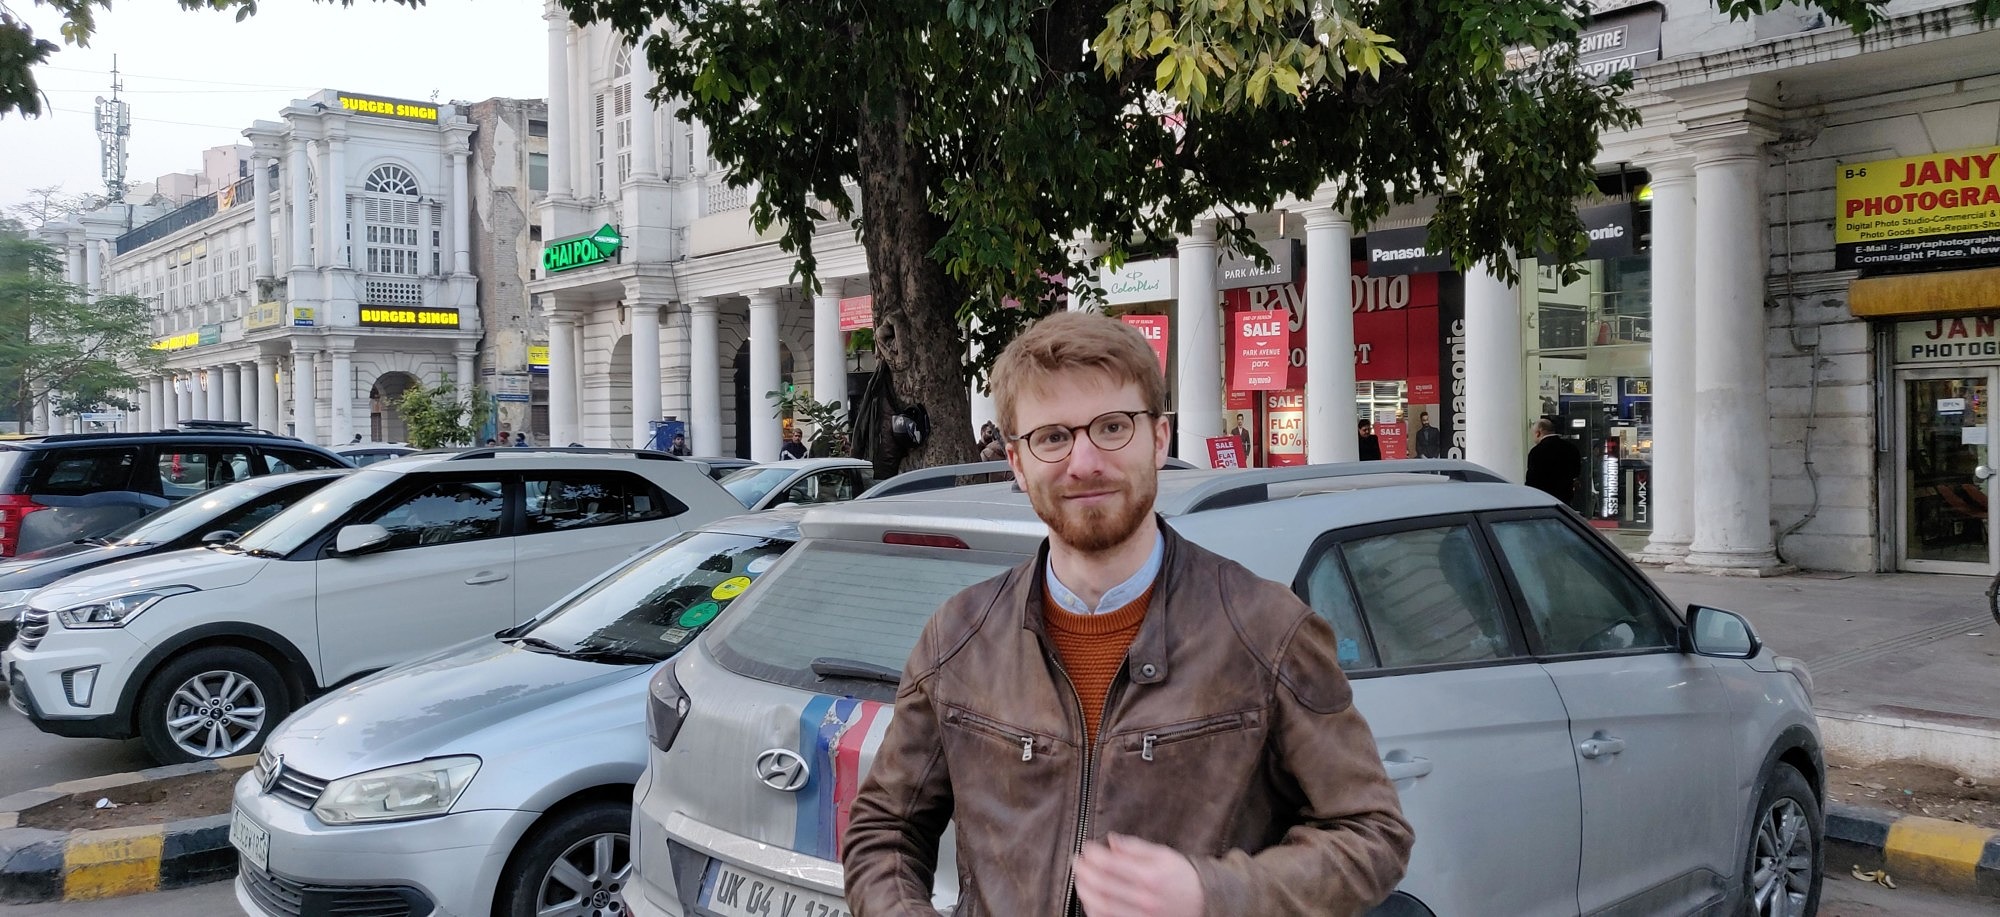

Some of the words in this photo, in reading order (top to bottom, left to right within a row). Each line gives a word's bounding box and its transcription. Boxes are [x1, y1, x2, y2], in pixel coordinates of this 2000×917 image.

[1579, 31, 1622, 54] ENTRE
[340, 97, 395, 115] BURGER
[396, 105, 437, 120] SINGH
[1845, 168, 1867, 179] B-6
[1900, 152, 2000, 188] JANY
[1846, 221, 1873, 231] Digital
[1875, 218, 1899, 228] Photo
[1902, 210, 1987, 226] Studio-Commercial
[1990, 210, 1996, 218] &
[1860, 230, 1885, 239] Photo
[1888, 227, 1915, 236] Goods
[1855, 243, 1887, 254] E-Mail
[1855, 250, 1924, 264] Connaught
[1927, 248, 1967, 260] Place,
[1970, 244, 2000, 255] New
[1225, 269, 1247, 280] PARK
[1111, 280, 1160, 294] ColorPlus
[361, 309, 416, 323] BURGER
[418, 312, 458, 325] SINGH
[1243, 322, 1281, 337] SALE
[1260, 348, 1281, 356] AVENUE
[1911, 342, 2000, 358] PHOTOG
[1269, 395, 1304, 408] SALE
[1271, 419, 1302, 430] FLAT
[1380, 428, 1401, 436] SALE
[1215, 441, 1235, 450] SALE
[1271, 432, 1302, 447] 50%
[1218, 452, 1235, 460] FLAT
[1608, 457, 1619, 515] MIRRORLESS
[1636, 481, 1647, 523] LUMIX
[717, 870, 746, 909] UK
[745, 881, 775, 917] 04
